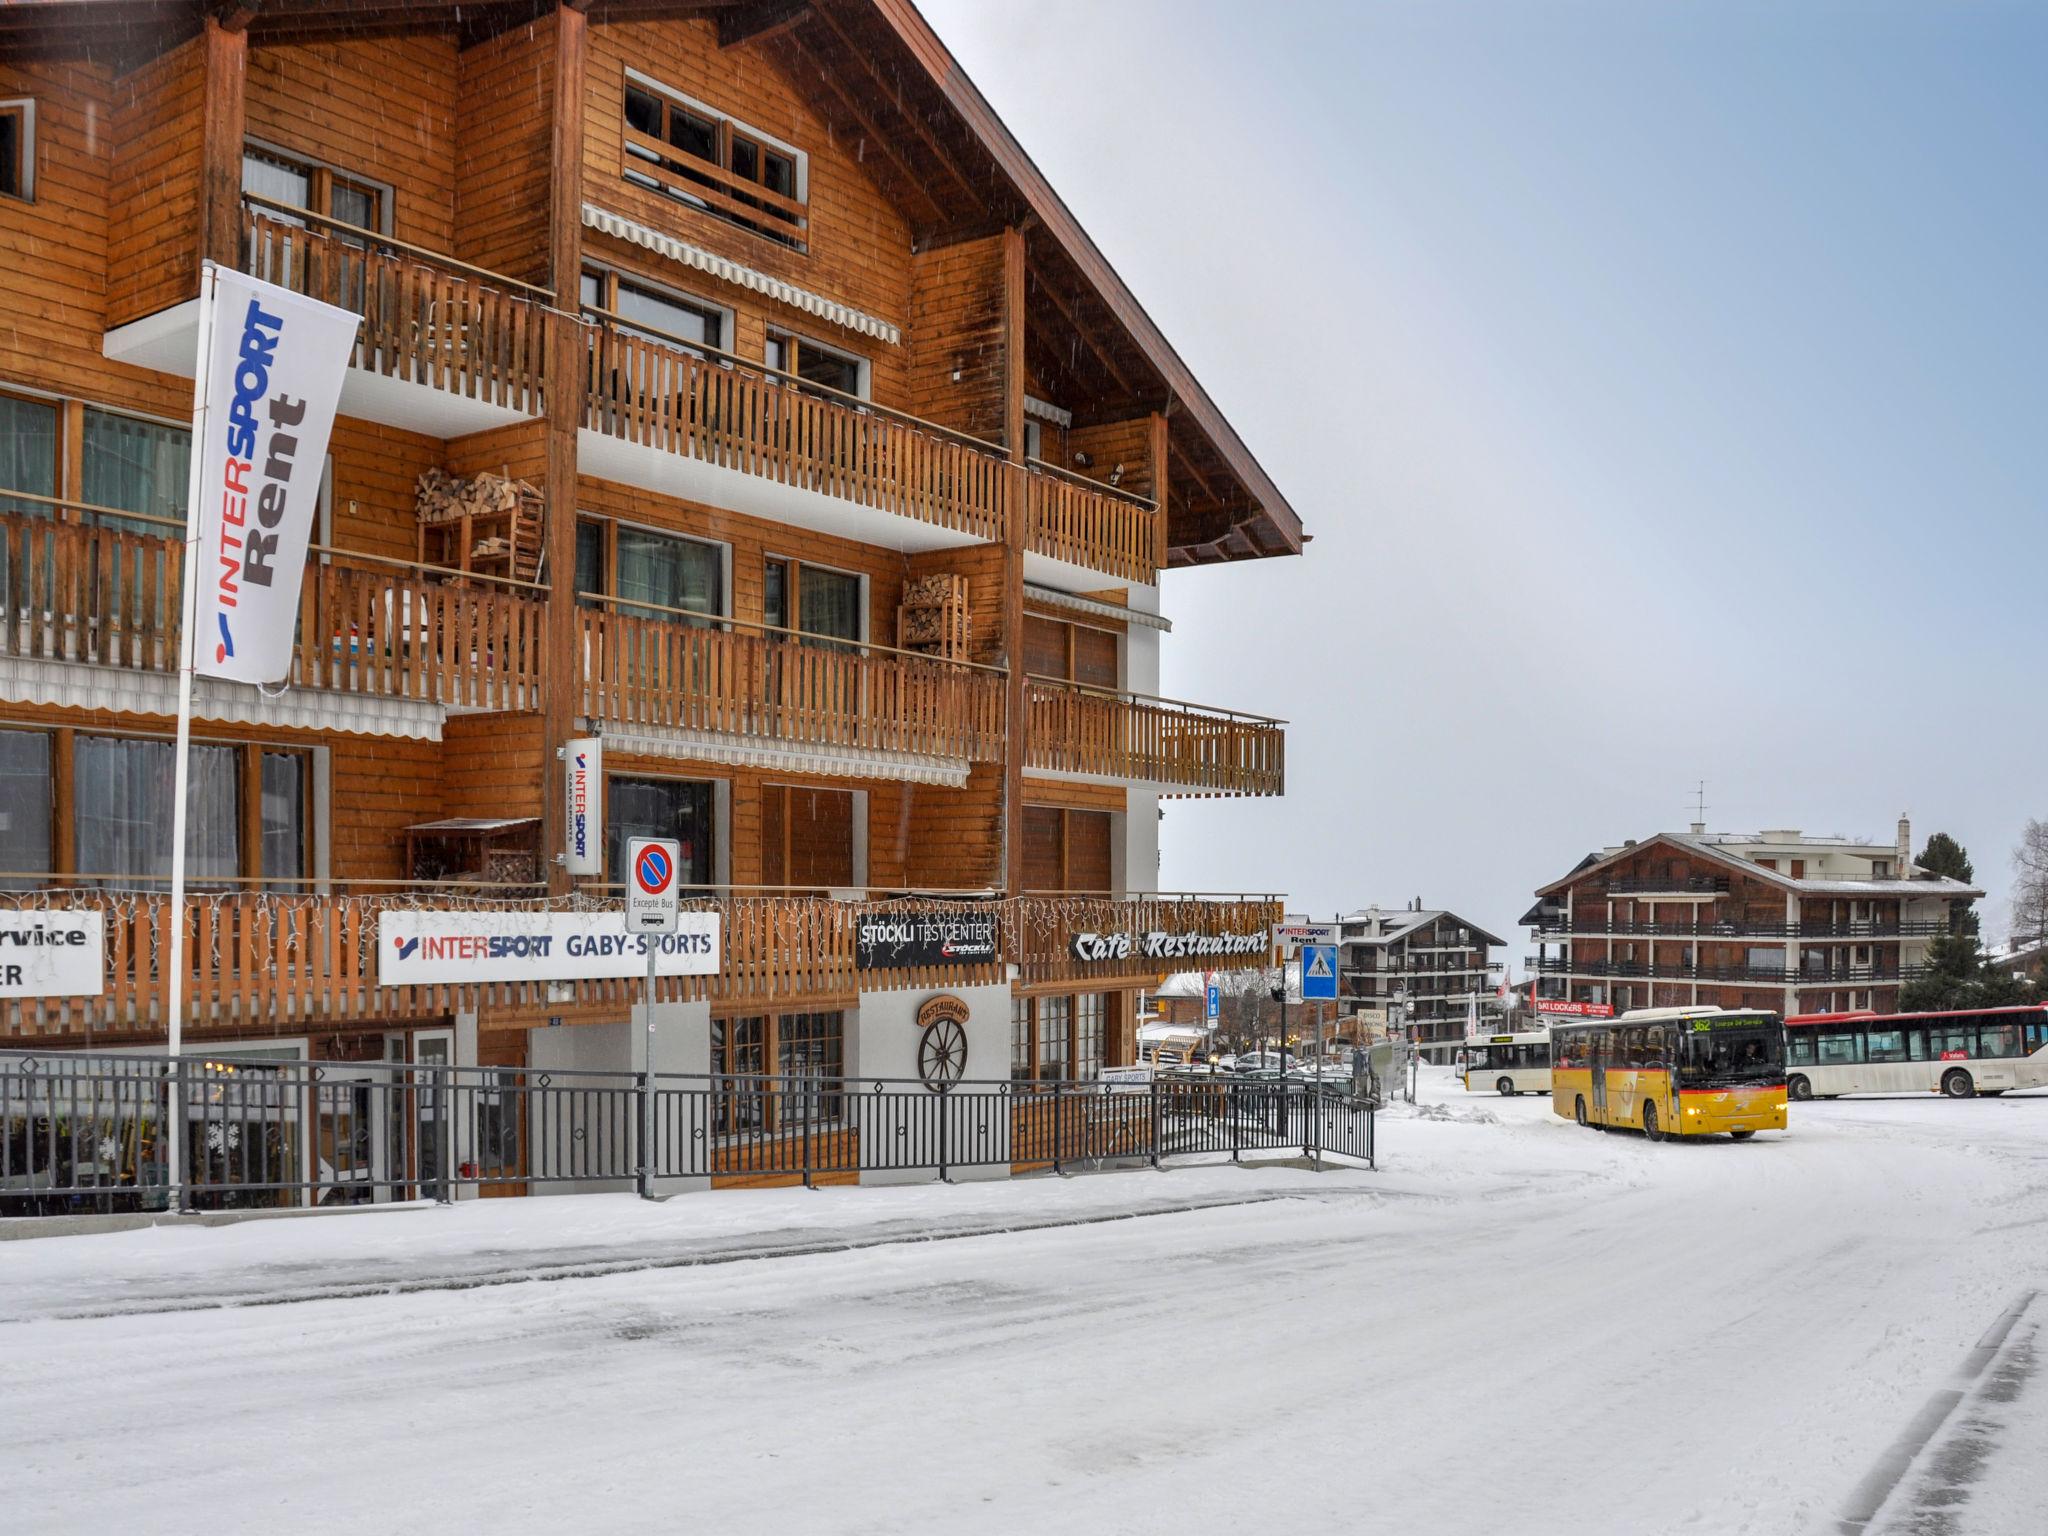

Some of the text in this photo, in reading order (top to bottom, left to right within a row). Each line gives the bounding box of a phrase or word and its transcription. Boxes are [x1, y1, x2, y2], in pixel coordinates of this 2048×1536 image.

[218, 299, 284, 608] INTERSPORT
[242, 392, 307, 588] Rent
[575, 770, 586, 858] INTERSPORT
[633, 897, 673, 910] Excepté Bus
[861, 921, 991, 943] STÖCKLI TESTCENTER
[1285, 927, 1330, 936] INTERSPORT
[1290, 936, 1317, 944] Rent
[422, 936, 553, 960] INTERSPORT
[1075, 930, 1269, 961] Café Restaurant
[1537, 1002, 1549, 1010] SKI
[1549, 1003, 1582, 1012] LOCKERS
[1692, 1019, 1711, 1031] 362
[1124, 1072, 1146, 1081] SPORTS
